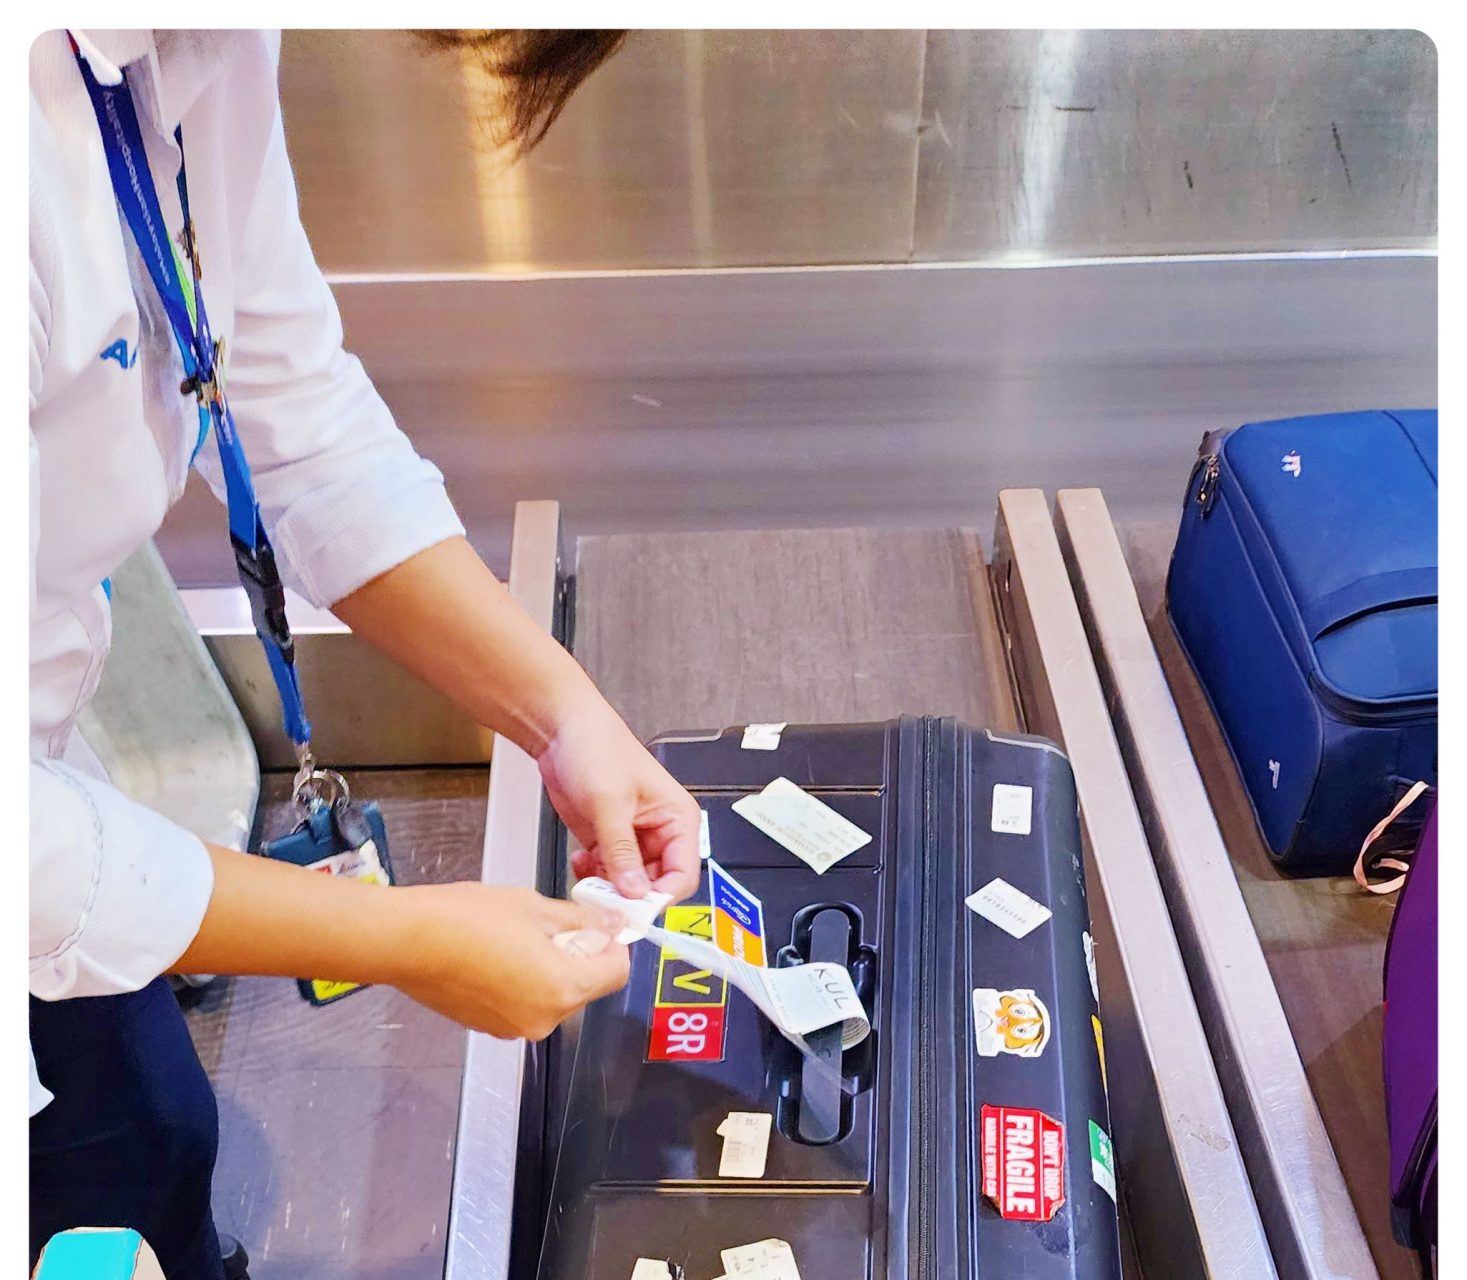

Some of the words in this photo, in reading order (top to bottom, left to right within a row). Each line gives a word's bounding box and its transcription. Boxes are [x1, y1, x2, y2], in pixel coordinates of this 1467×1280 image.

[813, 968, 849, 1010] KUL
[666, 1012, 709, 1055] 8R
[1005, 1114, 1037, 1214] FRAGILE
[1043, 1130, 1060, 1168] DON'T
[1043, 1168, 1061, 1201] DROP
